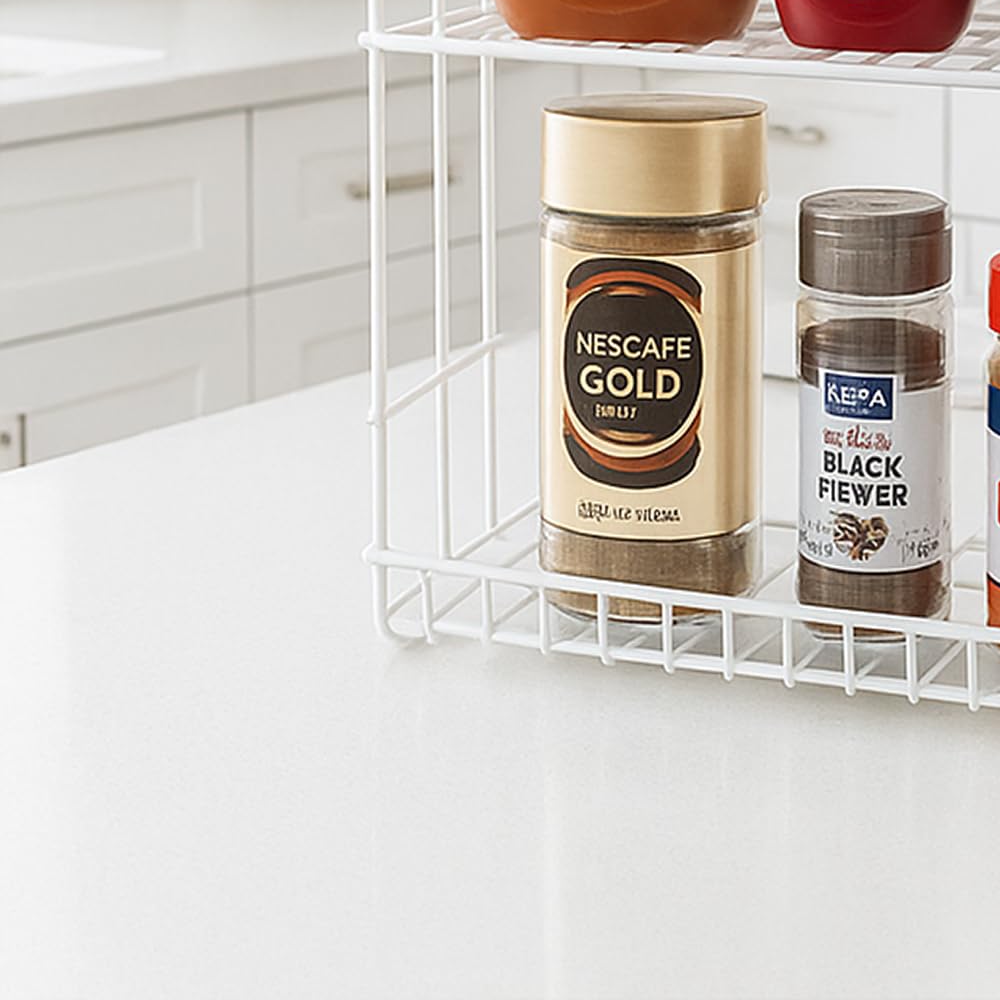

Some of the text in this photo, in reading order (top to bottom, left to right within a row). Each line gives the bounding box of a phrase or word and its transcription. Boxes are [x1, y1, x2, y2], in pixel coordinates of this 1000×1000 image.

[576, 331, 693, 360] NESCAFE
[579, 364, 682, 400] GOLD
[823, 450, 903, 478] BLACK
